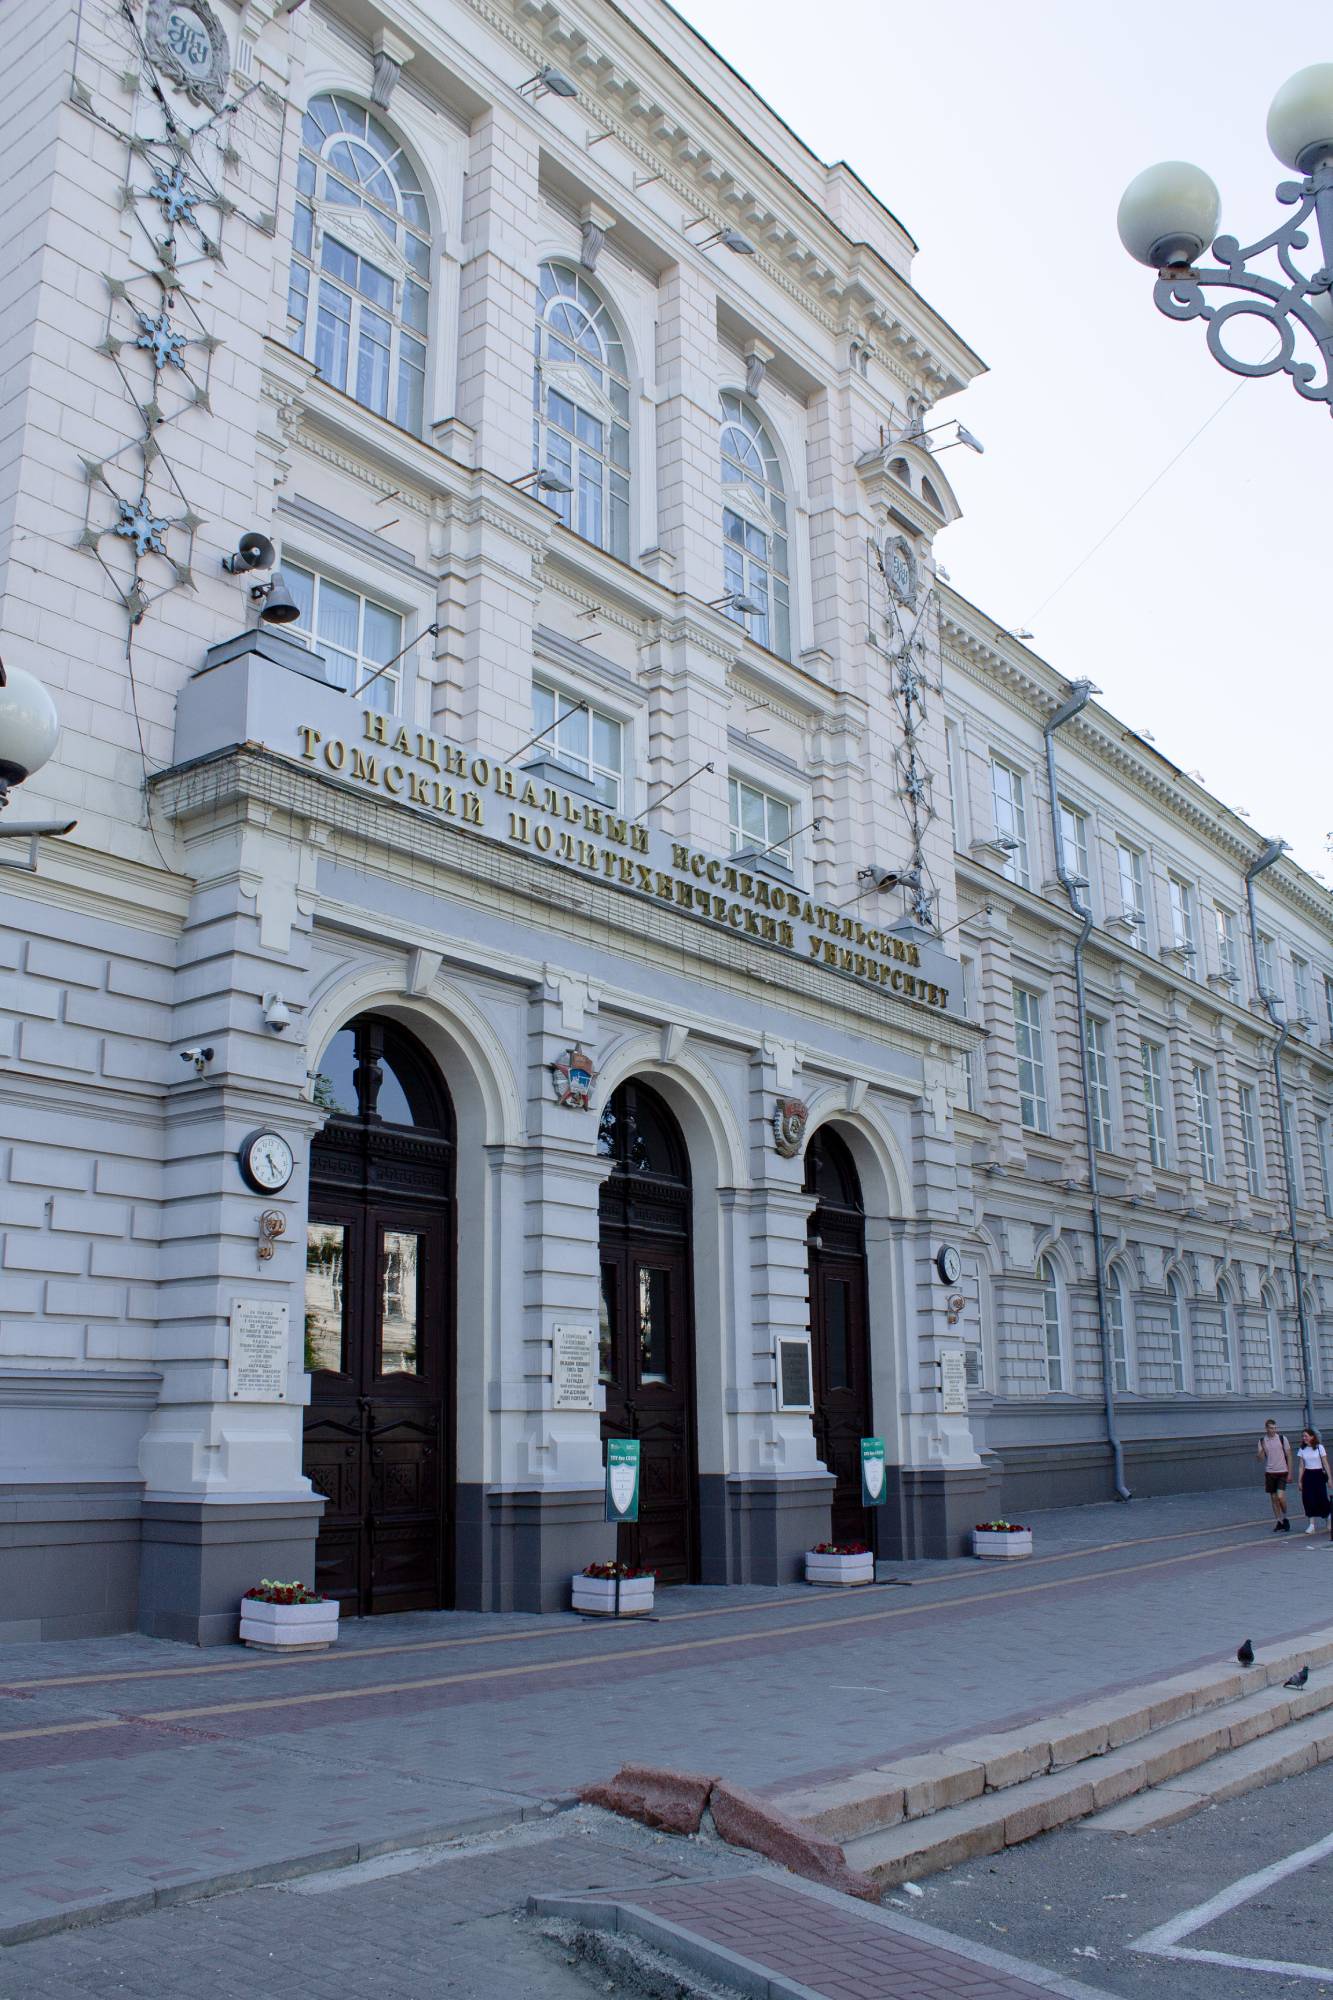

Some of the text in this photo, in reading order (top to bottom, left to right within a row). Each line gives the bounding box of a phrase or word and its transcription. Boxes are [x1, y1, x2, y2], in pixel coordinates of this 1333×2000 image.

[298, 724, 949, 1009] ТОМСКИЙ ПОЛИТЕХНИЧЕСКИЙ УНИВЕРСИТЕТ
[363, 710, 921, 968] НАЦИОНАЛЬНЫЙ ИССЛЕДОВАТЕЛЬСКИЙ
